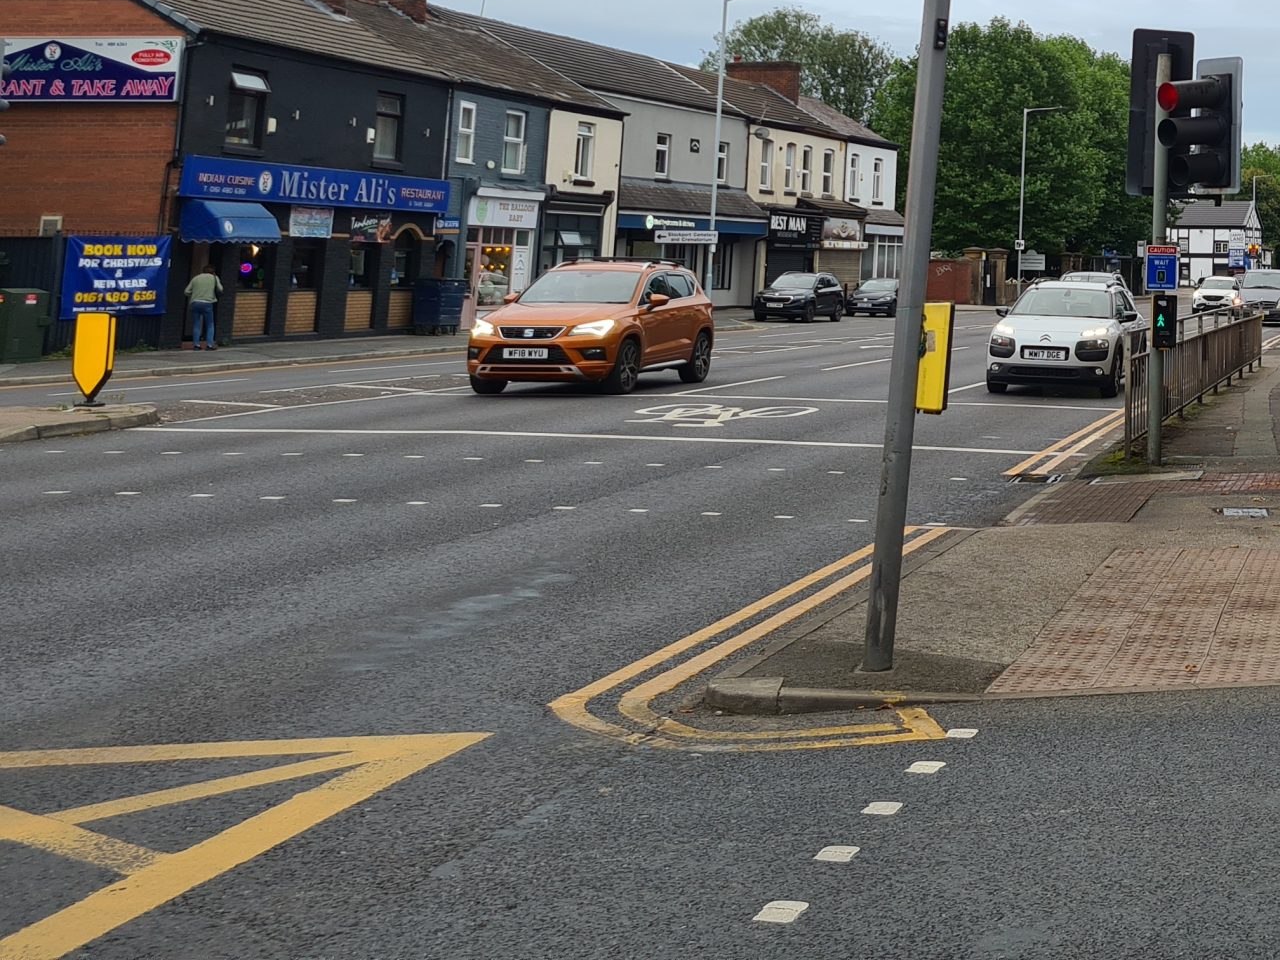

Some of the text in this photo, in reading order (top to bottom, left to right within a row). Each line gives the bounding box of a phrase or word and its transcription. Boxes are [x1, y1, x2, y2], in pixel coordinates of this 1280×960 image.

[3, 53, 103, 71] Mister Ali's
[51, 79, 64, 96] &
[72, 80, 116, 96] TAKE
[121, 77, 174, 96] AWAY
[199, 172, 255, 186] INDIAN CUISINE
[279, 170, 396, 205] Mister Ali's
[401, 187, 445, 200] RESTAURANT
[771, 215, 788, 231] BEST
[788, 217, 806, 234] MAN
[83, 244, 157, 256] BOOK NOW
[78, 257, 162, 268] FOR CHRISTMAS
[1154, 259, 1169, 267] WAIT
[115, 269, 123, 278] &
[94, 279, 148, 289] NEW YEAR
[508, 349, 526, 358] WF18
[1046, 351, 1061, 359] DGE
